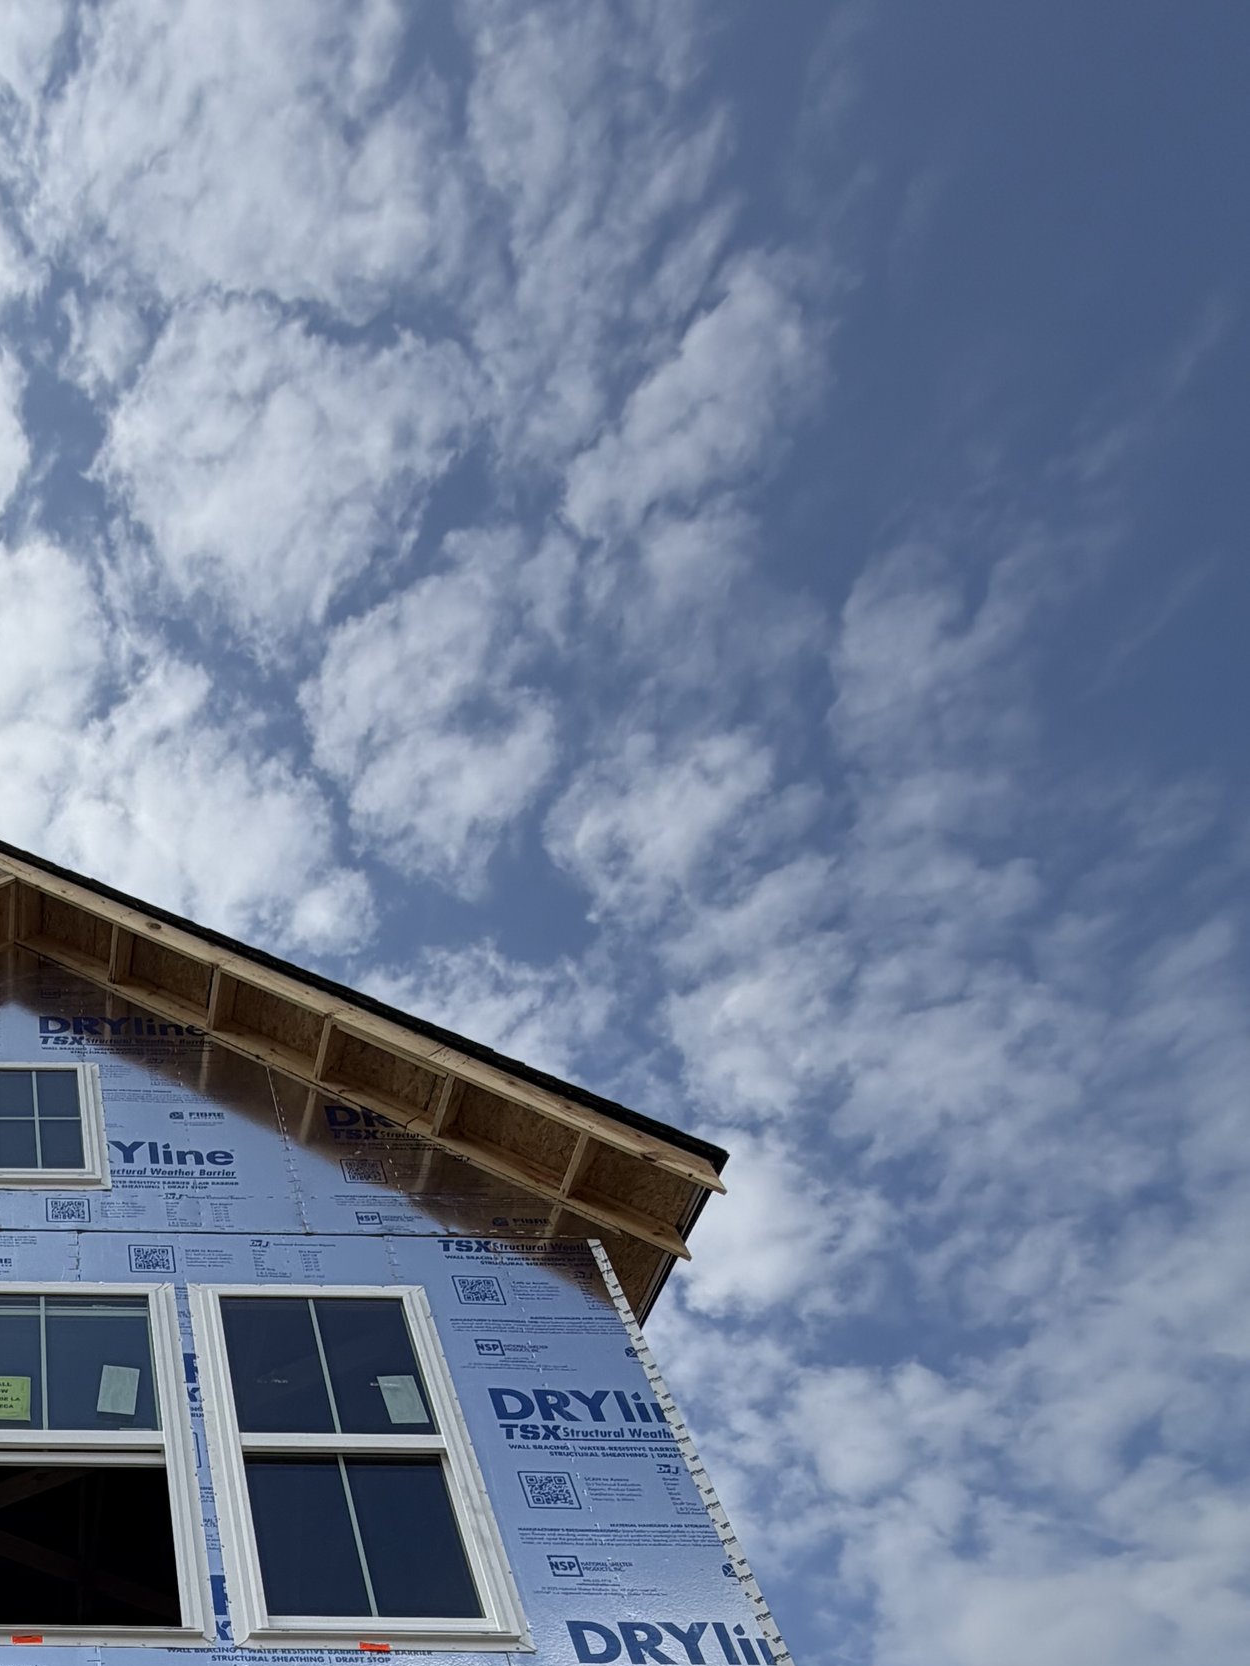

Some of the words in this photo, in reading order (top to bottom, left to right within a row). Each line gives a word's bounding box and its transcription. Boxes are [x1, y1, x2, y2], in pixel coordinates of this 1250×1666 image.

[39, 1036, 84, 1046] TSX
[438, 1240, 492, 1252] TSX
[487, 1387, 668, 1422] DRYli
[499, 1423, 562, 1441] TSX
[563, 1427, 625, 1439] Structural
[565, 1620, 778, 1666] DRYli
[211, 1655, 269, 1663] STRUCTURAL
[271, 1655, 325, 1664] SHEATHING
[335, 1656, 365, 1664] DRAFT
[367, 1656, 391, 1664] STOP
